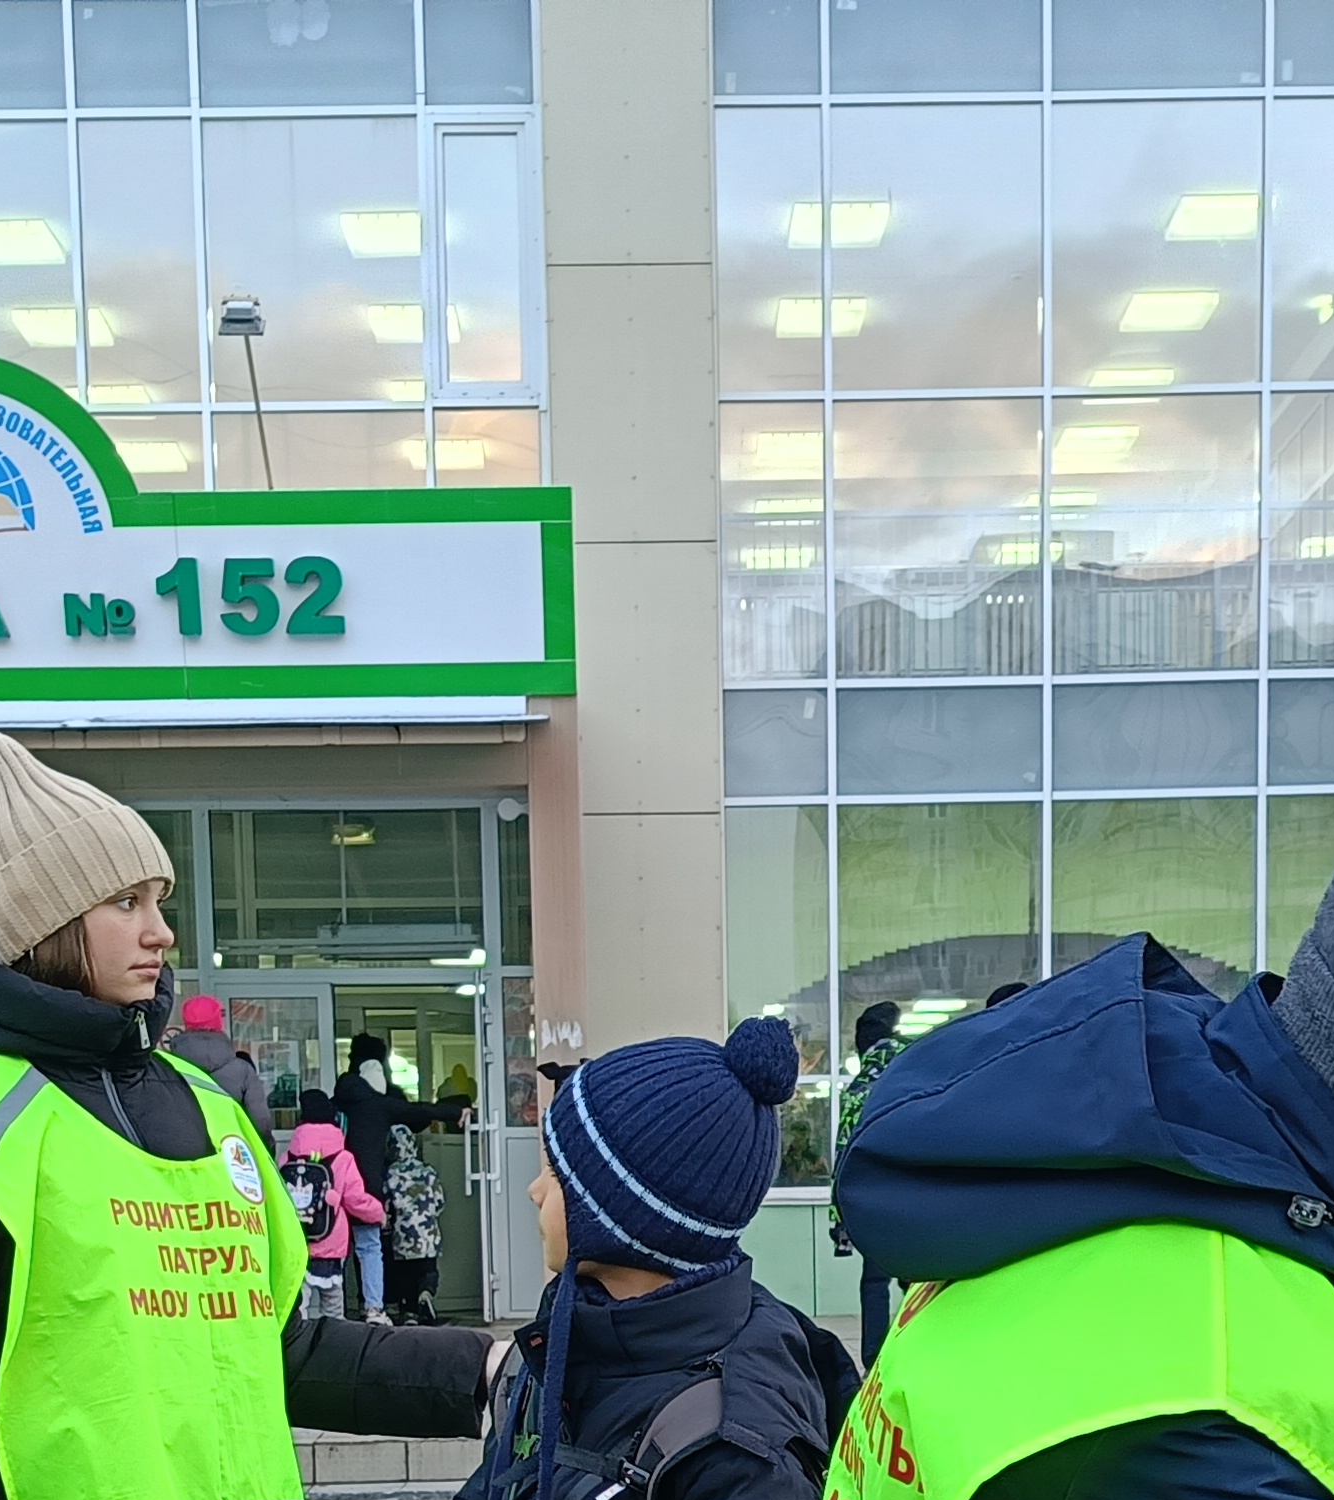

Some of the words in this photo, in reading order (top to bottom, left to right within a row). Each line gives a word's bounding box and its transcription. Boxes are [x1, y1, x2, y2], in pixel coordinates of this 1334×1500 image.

[63, 592, 137, 637] №
[155, 556, 348, 637] 152
[109, 1197, 265, 1237] РОДИТЕЛЬИЙ
[158, 1244, 262, 1276] ПАТРУЛЬ
[128, 1287, 188, 1318] МАОУ
[198, 1291, 237, 1320] СШ
[248, 1289, 274, 1318] №
